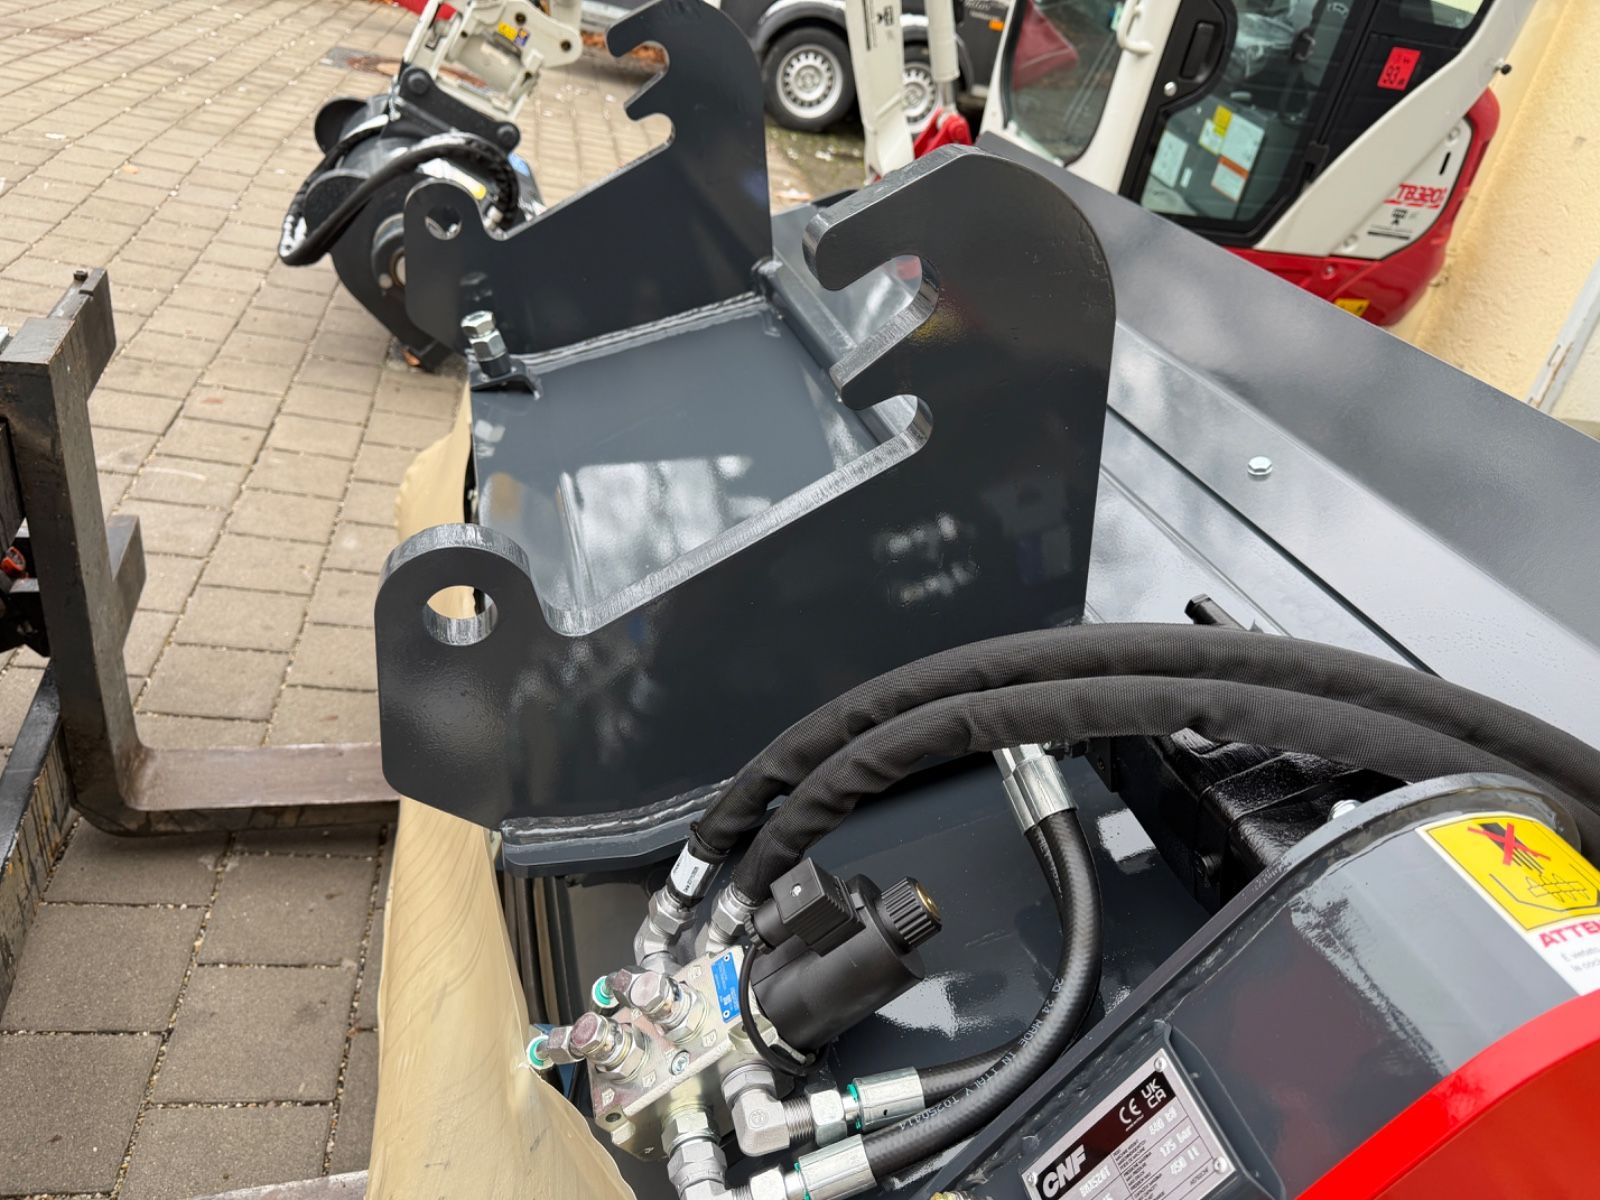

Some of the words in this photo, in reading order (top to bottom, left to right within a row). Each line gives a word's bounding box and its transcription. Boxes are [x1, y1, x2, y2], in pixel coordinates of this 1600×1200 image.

[1018, 1019, 1043, 1048] MADE
[1001, 1050, 1017, 1066] IN
[964, 1066, 999, 1097] ITALY
[1141, 1078, 1161, 1099] UK
[1119, 1097, 1142, 1124] CE
[1147, 1088, 1167, 1109] CA
[1176, 1125, 1192, 1143] bar
[1043, 1144, 1087, 1198] CNF
